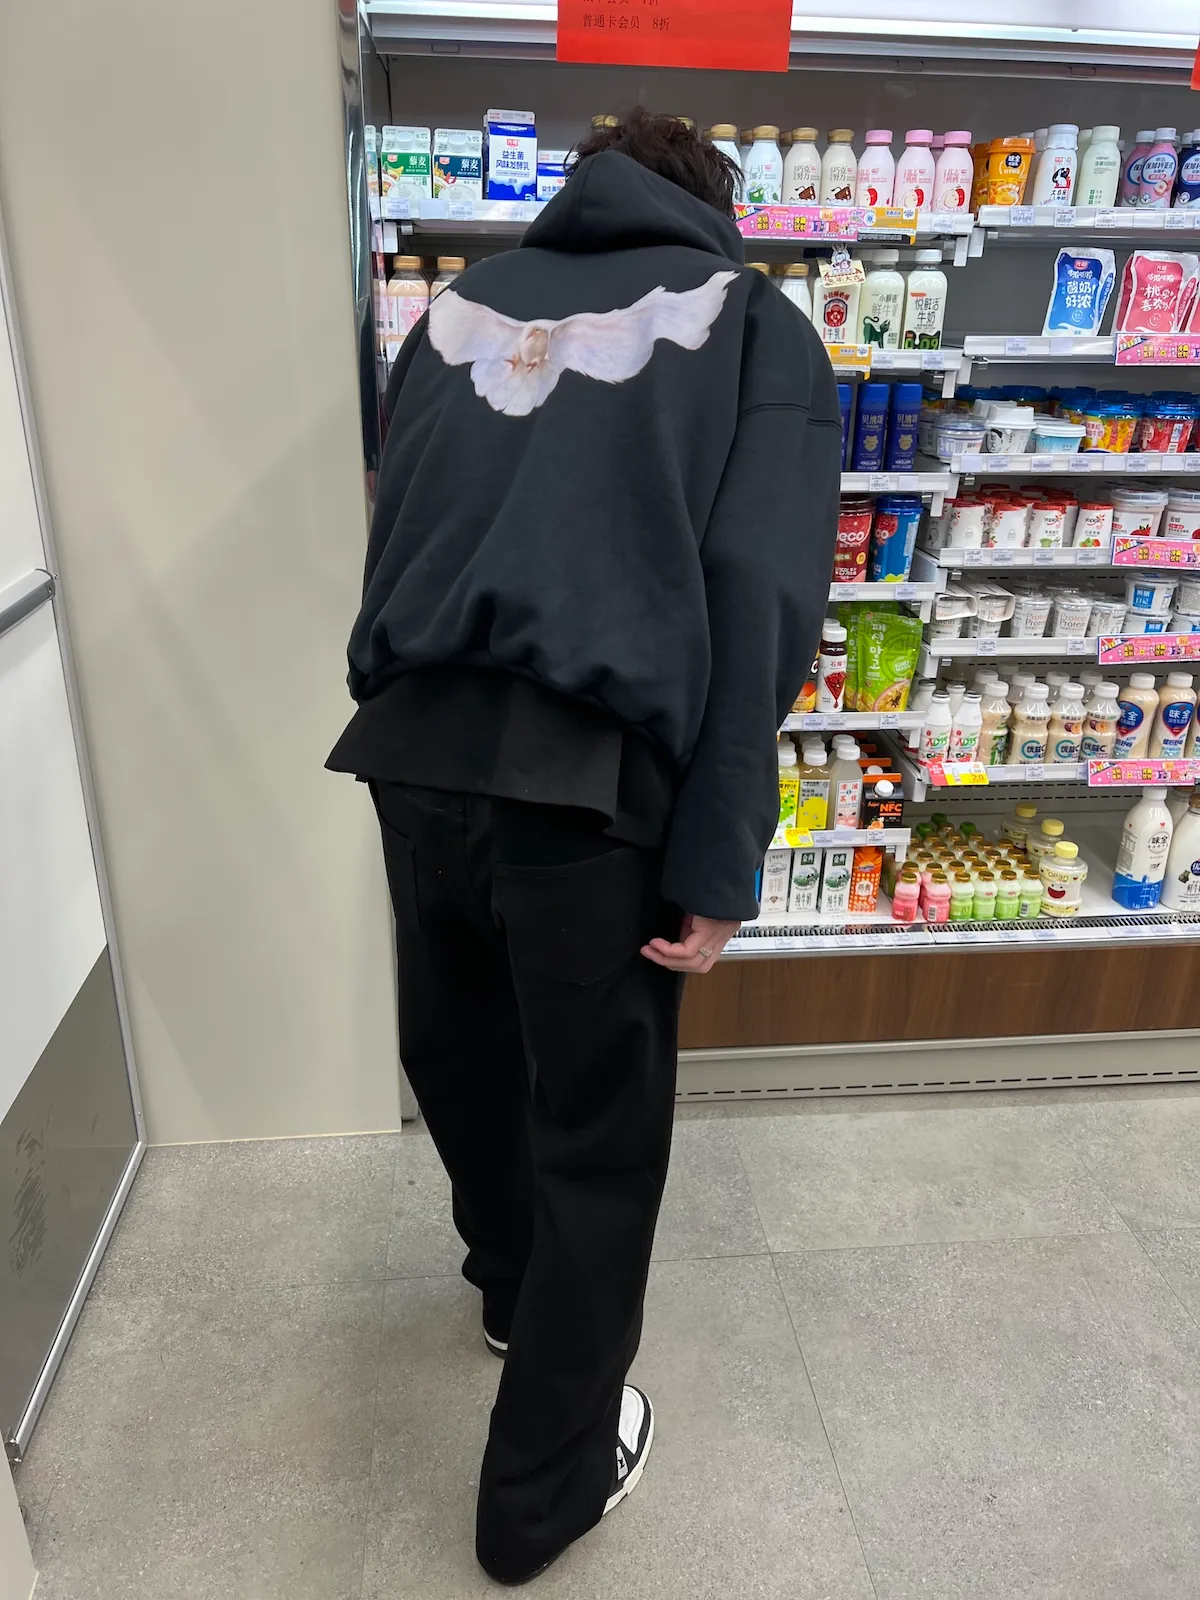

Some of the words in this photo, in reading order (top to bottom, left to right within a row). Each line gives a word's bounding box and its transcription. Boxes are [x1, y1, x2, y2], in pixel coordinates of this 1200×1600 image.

[583, 13, 640, 29] 普通卡会员
[652, 17, 671, 31] 8折
[409, 155, 426, 166] 藜麦
[502, 150, 524, 160] 益生菌
[461, 158, 479, 170] 藜麦
[496, 160, 530, 171] 风味发酵乳
[915, 297, 939, 311] 悦鲜活
[1066, 294, 1092, 308] 好浓
[872, 302, 898, 317] 鲜牛奶
[917, 311, 936, 324] 牛奶
[827, 327, 840, 340] 牛乳
[862, 414, 884, 424] 贝纳颂
[897, 413, 918, 424] 贝纳颂
[836, 530, 865, 542] eco
[1169, 709, 1191, 719] 味全
[1084, 742, 1108, 752] 优益C
[880, 803, 902, 812] NFC
[1151, 836, 1168, 844] 味全
[795, 892, 812, 907] 纯牛奶
[827, 893, 844, 908] 纯牛奶
